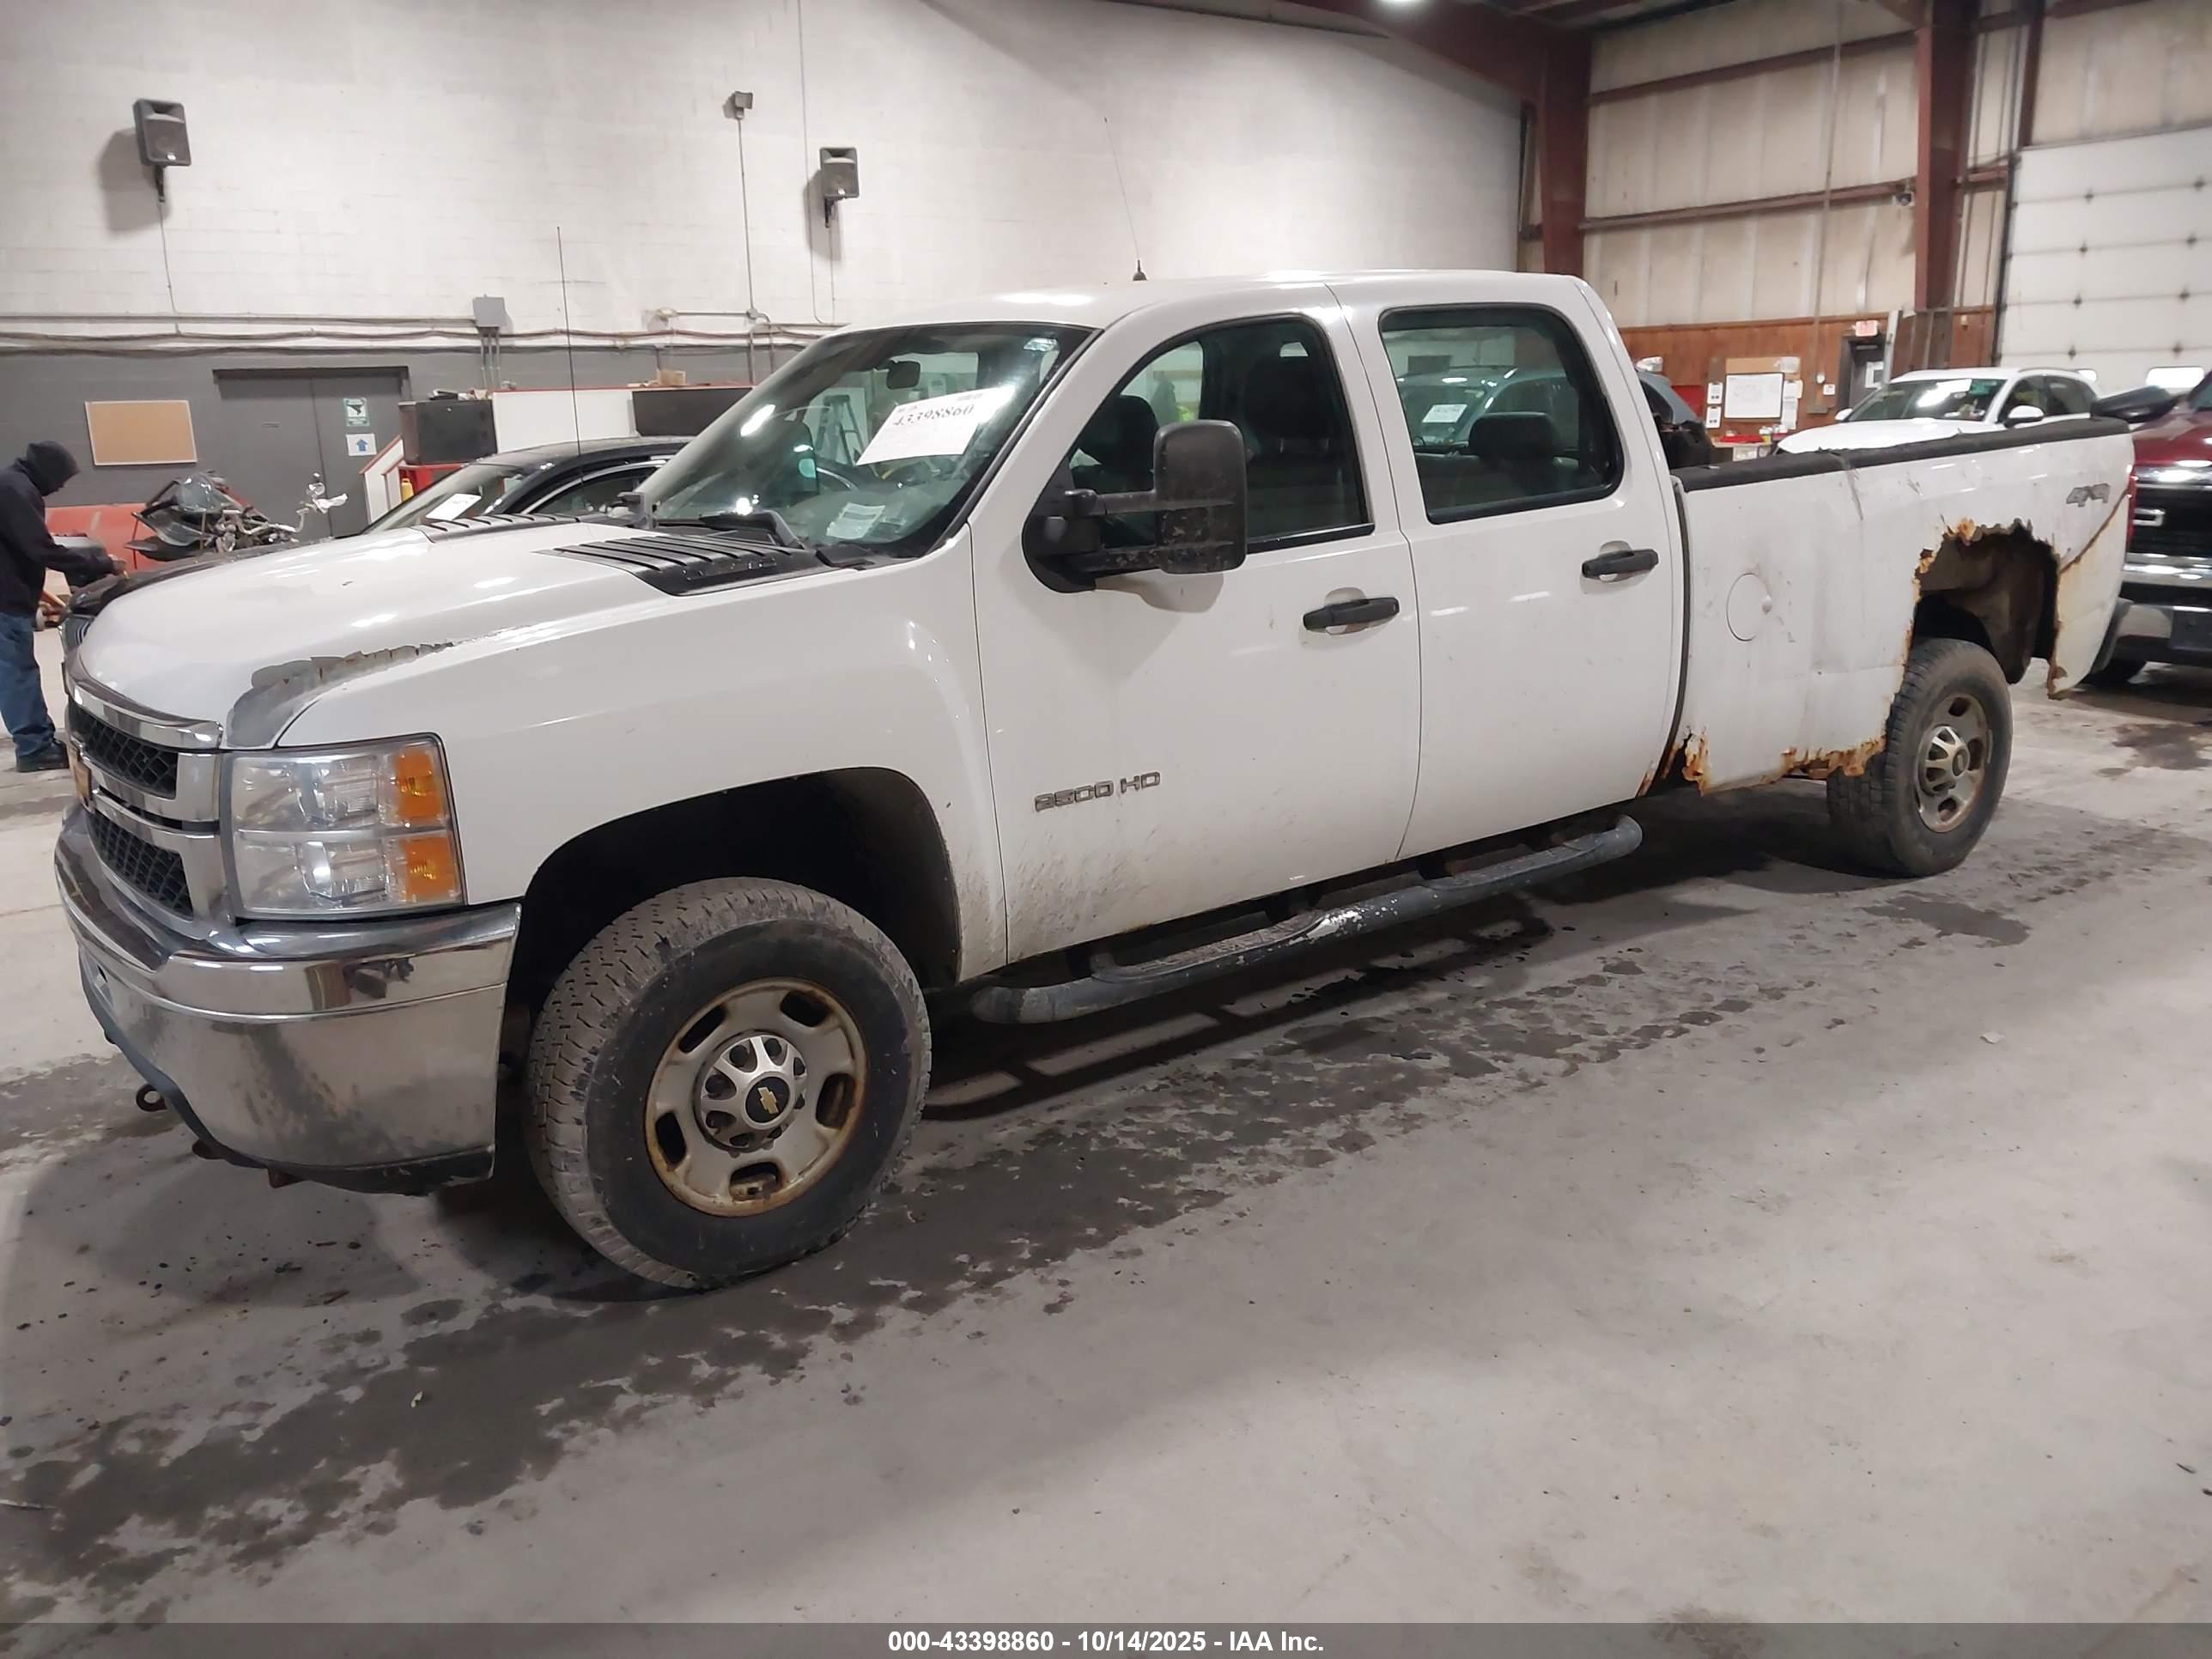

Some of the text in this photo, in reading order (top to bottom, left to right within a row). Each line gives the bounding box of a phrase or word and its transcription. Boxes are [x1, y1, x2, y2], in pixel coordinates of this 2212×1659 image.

[893, 404, 975, 427] 43398860
[1034, 771, 1161, 812] 2500 HD
